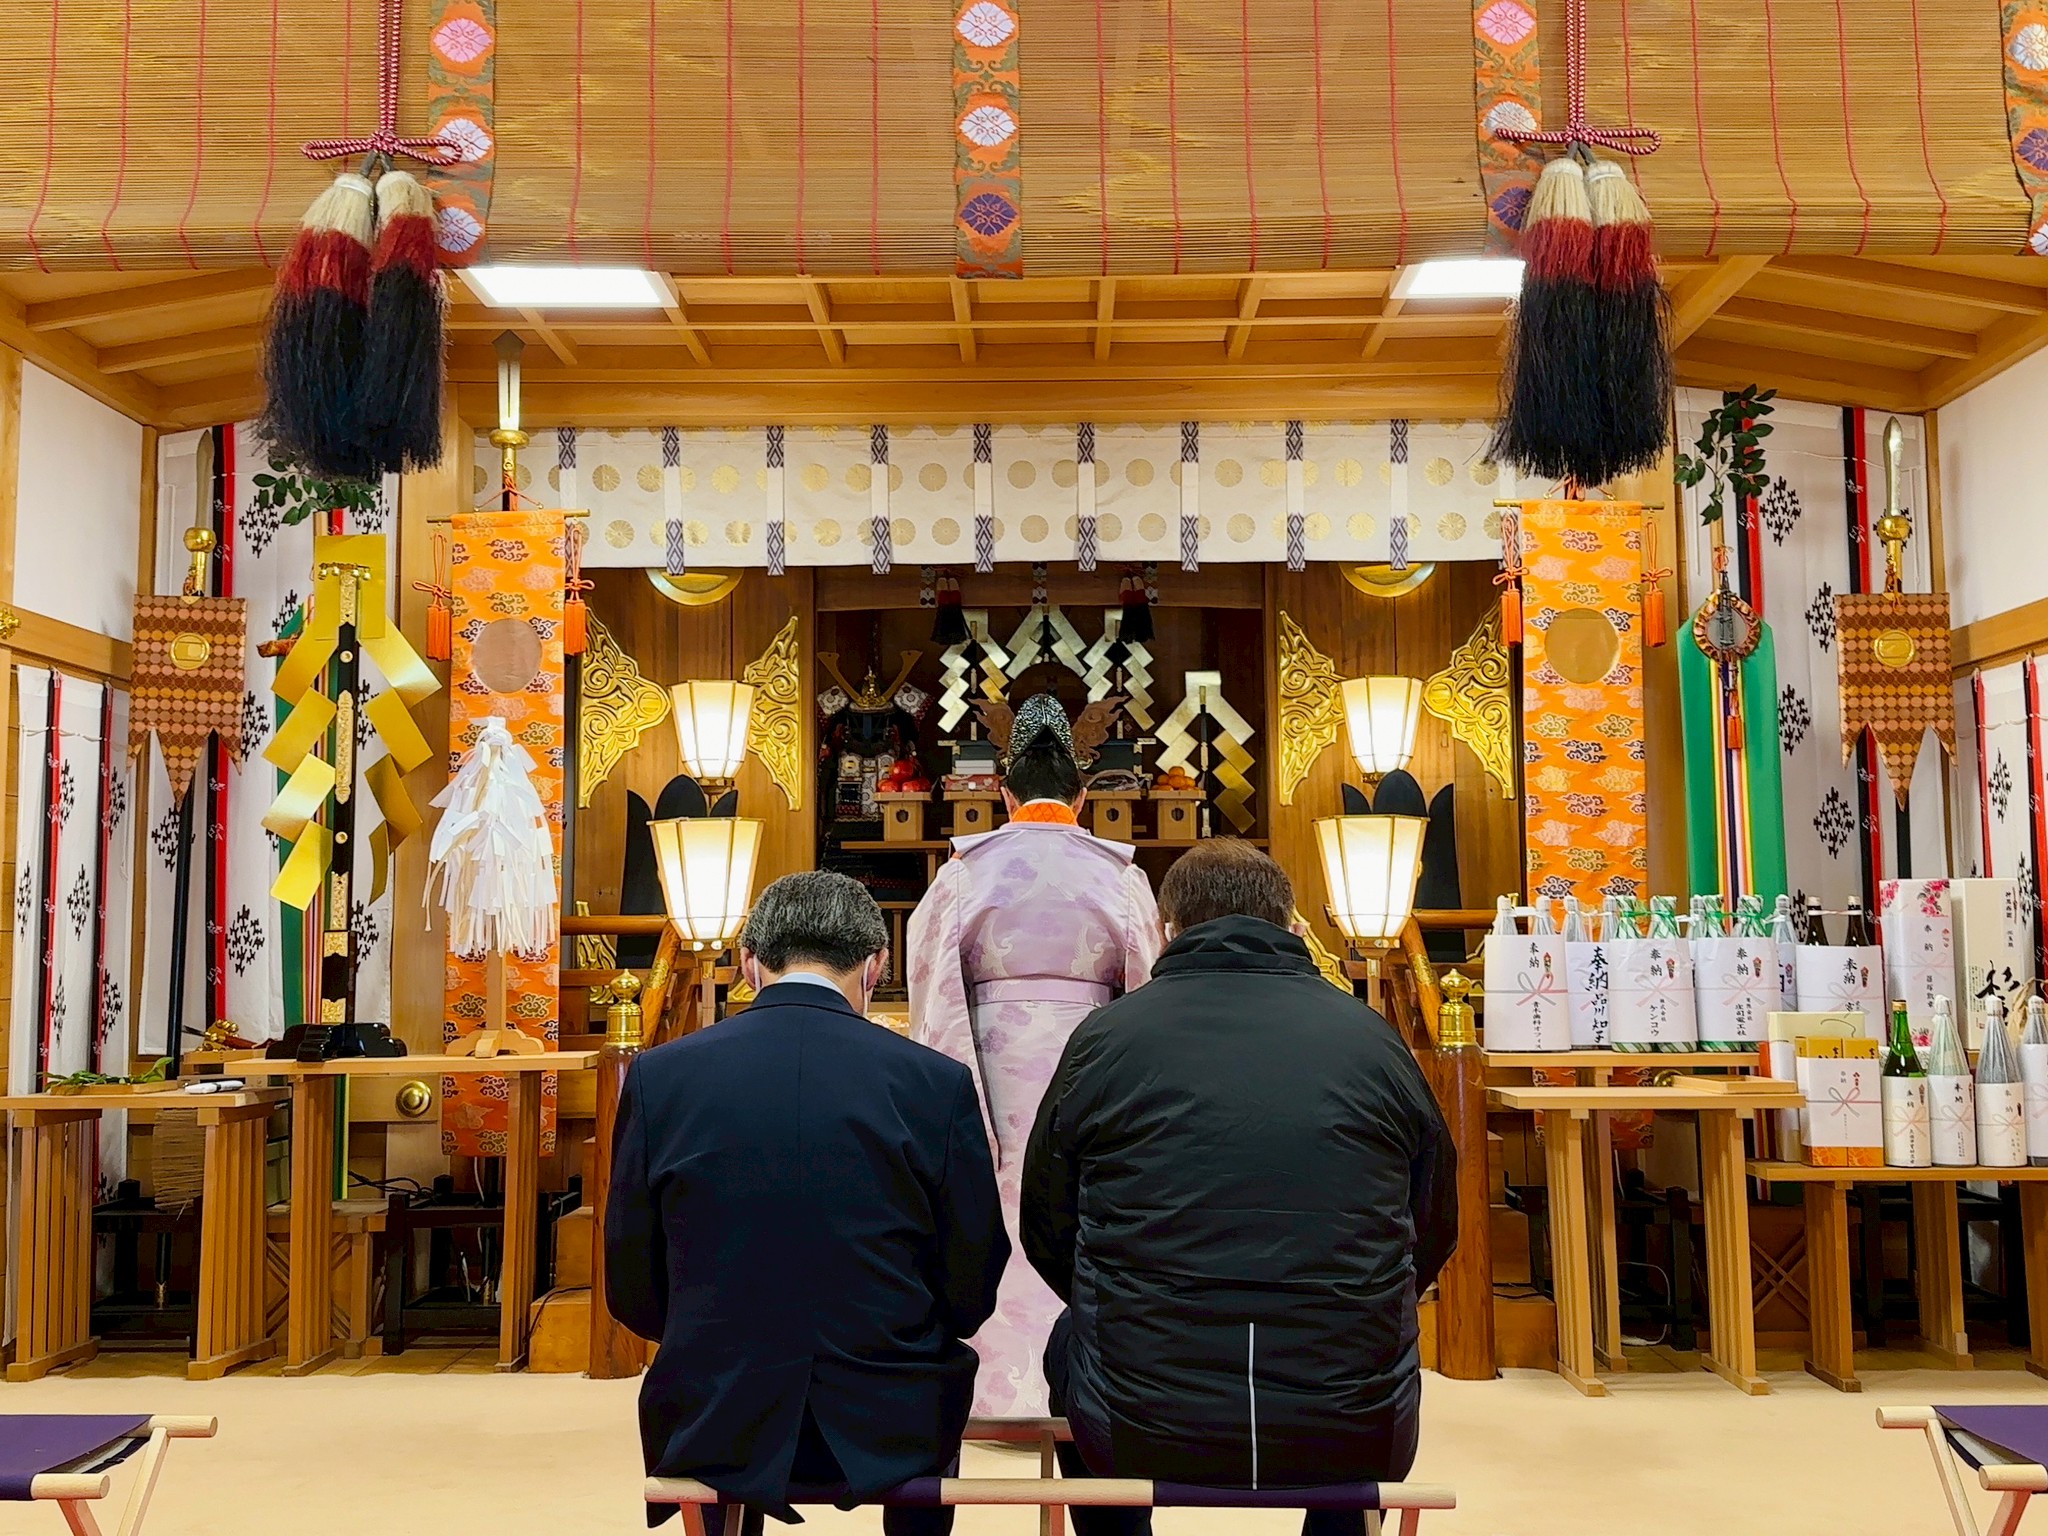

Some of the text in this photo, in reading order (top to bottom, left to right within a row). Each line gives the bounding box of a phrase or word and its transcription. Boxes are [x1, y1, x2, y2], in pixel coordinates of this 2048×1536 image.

[1650, 948, 1662, 976] 奉納
[1736, 947, 1749, 975] 奉納
[1843, 957, 1857, 985] 奉納
[1649, 1004, 1659, 1036] ケンコウ
